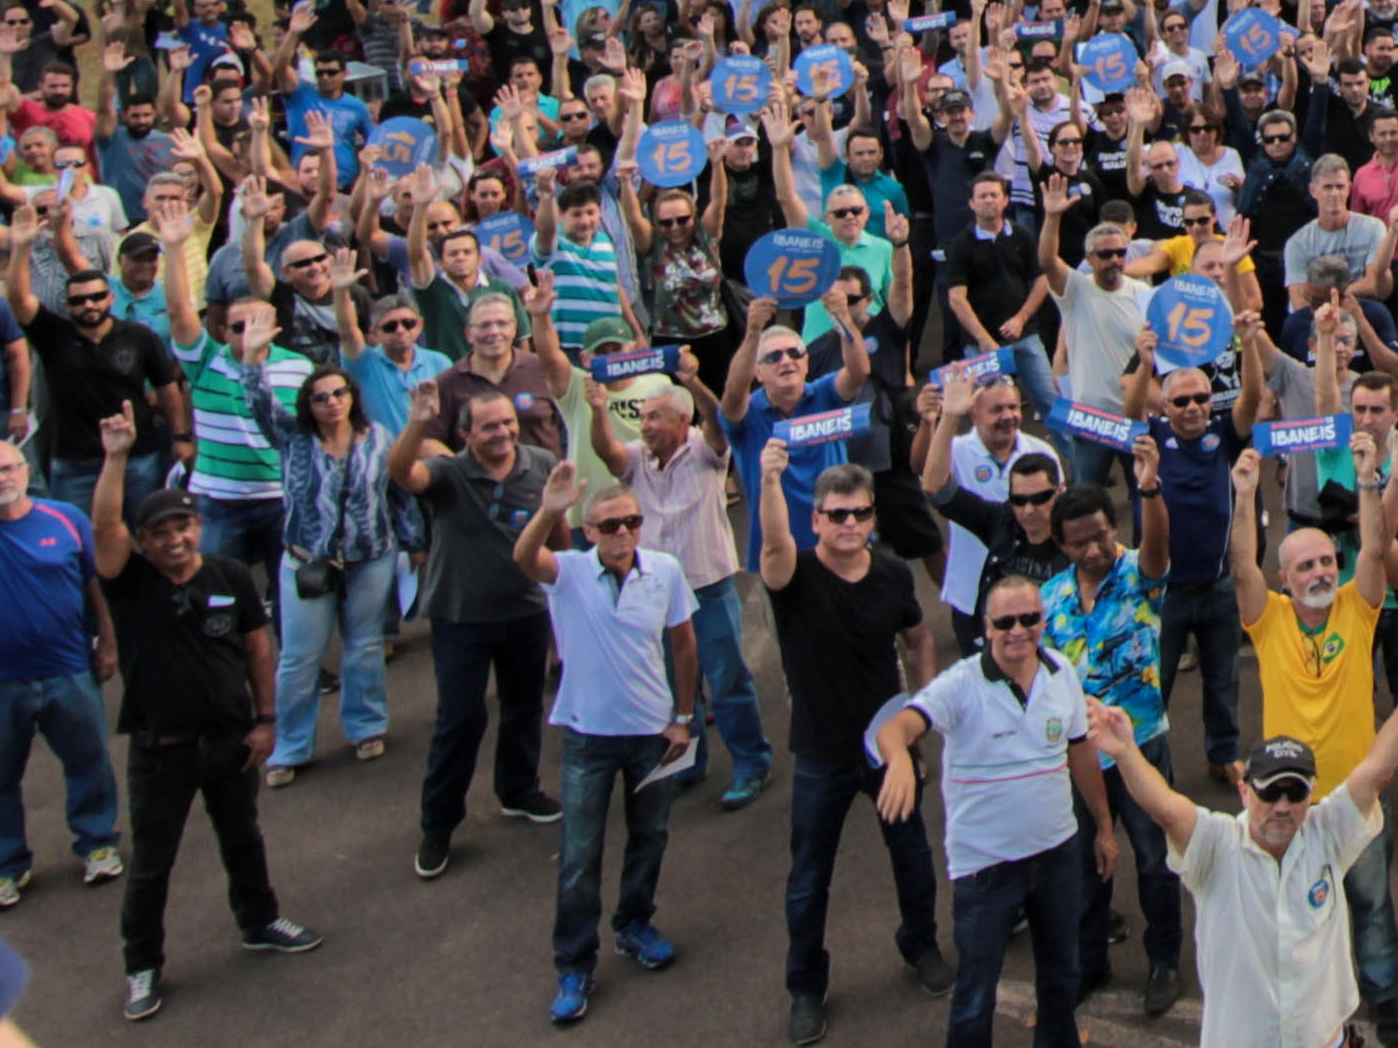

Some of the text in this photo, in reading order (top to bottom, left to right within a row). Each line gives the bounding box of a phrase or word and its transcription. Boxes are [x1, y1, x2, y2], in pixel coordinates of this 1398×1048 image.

[1240, 25, 1272, 55] 15
[1093, 54, 1125, 81] 15
[723, 74, 758, 99] 15
[651, 141, 691, 170] 15
[767, 255, 820, 294] 15
[1174, 280, 1218, 299] IBANEIS
[1167, 302, 1214, 347] 15
[605, 354, 663, 378] IBANEIS
[789, 415, 853, 442] IBANEIS
[1067, 408, 1131, 442] IBANEIS
[1271, 423, 1336, 447] IBANEIS
